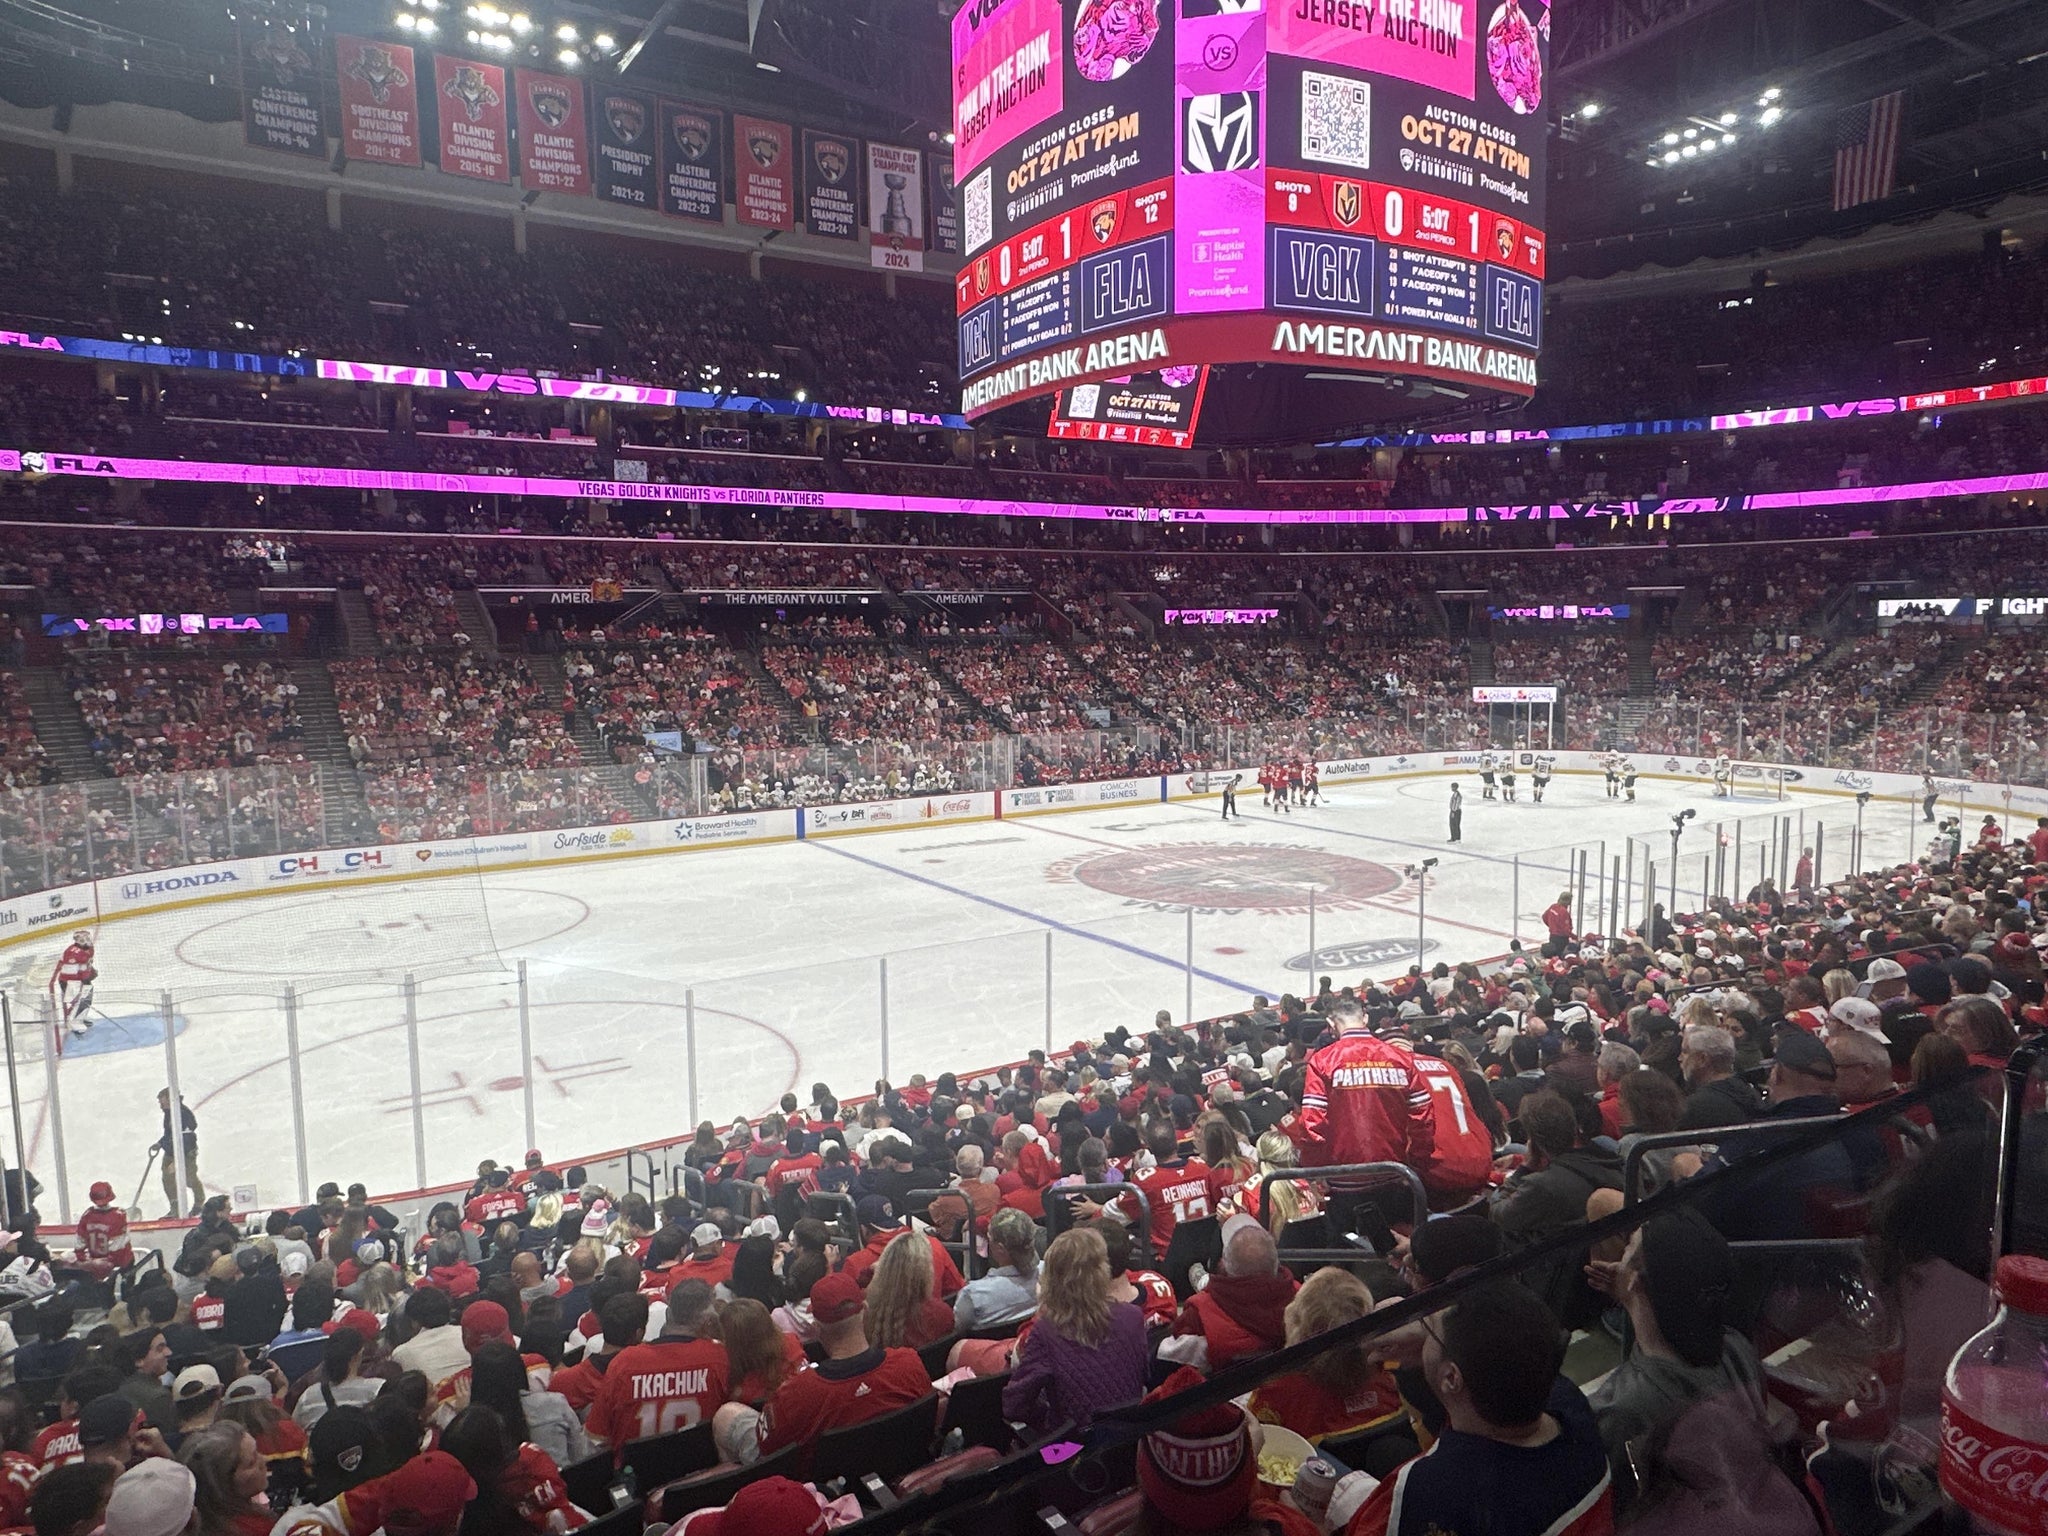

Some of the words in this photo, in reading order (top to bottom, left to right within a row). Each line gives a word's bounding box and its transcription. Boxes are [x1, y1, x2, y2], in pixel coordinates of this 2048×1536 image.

[1419, 0, 1462, 40] RINK
[1296, 0, 1374, 33] JERSEY
[1384, 12, 1456, 58] AUCTION
[1210, 46, 1232, 62] VS
[992, 58, 1015, 98] THE
[1016, 29, 1050, 79] RINK
[252, 98, 319, 122] CONFERENCE
[351, 104, 408, 122] SOUTHEAST
[962, 101, 992, 148] JERSEY
[996, 64, 1046, 118] AUCTION
[255, 112, 317, 136] CHAMPIONS
[359, 118, 404, 134] DIVISION
[452, 122, 495, 140] ATLANTIC
[1425, 104, 1476, 130] AUCTION
[1480, 122, 1516, 146] CLOSES
[352, 129, 412, 146] CHAMPIONS
[534, 133, 574, 148] ATLANTIC
[1022, 123, 1065, 161] AUCTION
[1069, 105, 1114, 136] CLOSES
[454, 134, 494, 150] DIVISION
[1401, 115, 1446, 148] OCT
[1448, 128, 1472, 156] 27
[1474, 137, 1497, 164] AT
[1498, 142, 1530, 179] 7PM
[448, 144, 502, 164] CHAMPIONS
[535, 146, 574, 162] DIVISION
[872, 147, 899, 162] STANLEY
[903, 152, 917, 163] CUP
[1007, 156, 1038, 194] OCT
[1040, 144, 1062, 177] 27
[1064, 132, 1089, 166] AT
[1092, 112, 1139, 152] 7PM
[460, 160, 495, 176] 2015-16
[529, 159, 582, 175] CHAMPIONS
[612, 160, 642, 176] TROPHY
[676, 163, 710, 179] EASTERN
[874, 159, 916, 174] CHAMPIONS
[1415, 159, 1472, 186] FOUNDATION
[538, 174, 574, 188] 2021-22
[669, 174, 717, 192] CONFERENCE
[748, 174, 782, 188] ATLANTIC
[1275, 181, 1311, 194] SHOTS
[612, 186, 644, 202] 2021-22
[671, 187, 716, 204] CHAMPIONS
[750, 185, 781, 200] DIVISION
[817, 186, 848, 200] EASTERN
[1135, 190, 1167, 208] SHOTS
[678, 200, 710, 214] 2022-23
[744, 196, 786, 213] CHAMPIONS
[810, 197, 854, 213] CONFERENCE
[812, 209, 853, 224] CHAMPIONS
[1145, 204, 1158, 224] 12
[1384, 191, 1402, 236] 0
[1422, 206, 1449, 232] 5:07
[818, 222, 848, 234] 2023-24
[1468, 212, 1478, 254] 1
[1060, 216, 1070, 260] 1
[1214, 240, 1245, 252] Baptist
[1415, 230, 1430, 240] 2nd
[1430, 232, 1456, 246] PERIOD
[1022, 235, 1044, 262] 5:07
[1214, 251, 1244, 262] Health
[1529, 248, 1538, 264] 12
[885, 253, 910, 268] 2024
[1000, 246, 1010, 286] 0
[1402, 251, 1425, 262] SHOT
[1426, 256, 1466, 272] ATTEMPTS
[1290, 240, 1360, 303] VGK
[1412, 266, 1450, 281] FACEOFF
[1450, 274, 1457, 282] %
[1094, 252, 1152, 319] FLA
[1402, 278, 1446, 294] FACEOFFS
[1447, 287, 1465, 298] WON
[1390, 289, 1395, 300] 4
[1427, 296, 1442, 306] PIM
[1470, 304, 1474, 314] 2
[1496, 277, 1532, 336] FLA
[1402, 306, 1426, 318] POWER
[1426, 310, 1443, 321] PLAY
[1444, 314, 1464, 324] GOALS
[0, 330, 64, 352] FLA
[964, 310, 990, 366] VGK
[1272, 321, 1423, 364] AMERANT
[1425, 337, 1482, 374] BANK
[1484, 350, 1537, 386] ARENA
[961, 362, 1028, 414] AMERANT
[1030, 347, 1082, 388] BANK
[1085, 328, 1170, 372] ARENA
[454, 370, 538, 394] VS
[1109, 396, 1131, 407] OCT
[1132, 398, 1143, 408] 27
[1144, 399, 1158, 410] AT
[1158, 400, 1181, 413] 7PM
[1820, 398, 1897, 418] VS
[826, 406, 864, 418] VGK
[909, 413, 942, 426] FLA
[1134, 428, 1140, 442] 1
[1430, 433, 1468, 444] VGK
[1514, 430, 1550, 440] FLA
[54, 458, 117, 474] FLA
[578, 482, 614, 496] VEGAS
[619, 485, 661, 498] GOLDEN
[665, 486, 710, 500] KNIGHTS
[729, 490, 771, 503] FLORIDA
[774, 492, 824, 506] PANTHERS
[1105, 508, 1134, 518] VGK
[1174, 512, 1206, 520] FLA
[551, 593, 594, 604] AMER
[725, 594, 746, 604] THE
[749, 594, 806, 604] AMERANT
[810, 594, 848, 604] VAULT
[935, 594, 985, 604] AMERANT
[1976, 598, 2048, 614] FIGH
[1238, 612, 1264, 620] FLA
[1580, 608, 1613, 616] FLA
[208, 617, 262, 630] FLA
[1325, 762, 1370, 775] AutoNation
[1100, 781, 1136, 791] COMCAST
[1100, 790, 1138, 800] BUSINESS
[943, 799, 971, 812] Coca-Cola
[695, 821, 730, 830] Broward
[732, 818, 757, 828] Health
[554, 832, 606, 848] Surfside
[146, 872, 239, 894] HONDA
[1317, 942, 1414, 968] Ford
[1332, 1068, 1408, 1088] PANTHERS
[1426, 1076, 1470, 1135] 7
[1162, 1180, 1208, 1203] REINHART
[196, 1304, 224, 1320] BOBRO
[632, 1368, 709, 1400] TKACHUK
[45, 1432, 84, 1460] BARK
